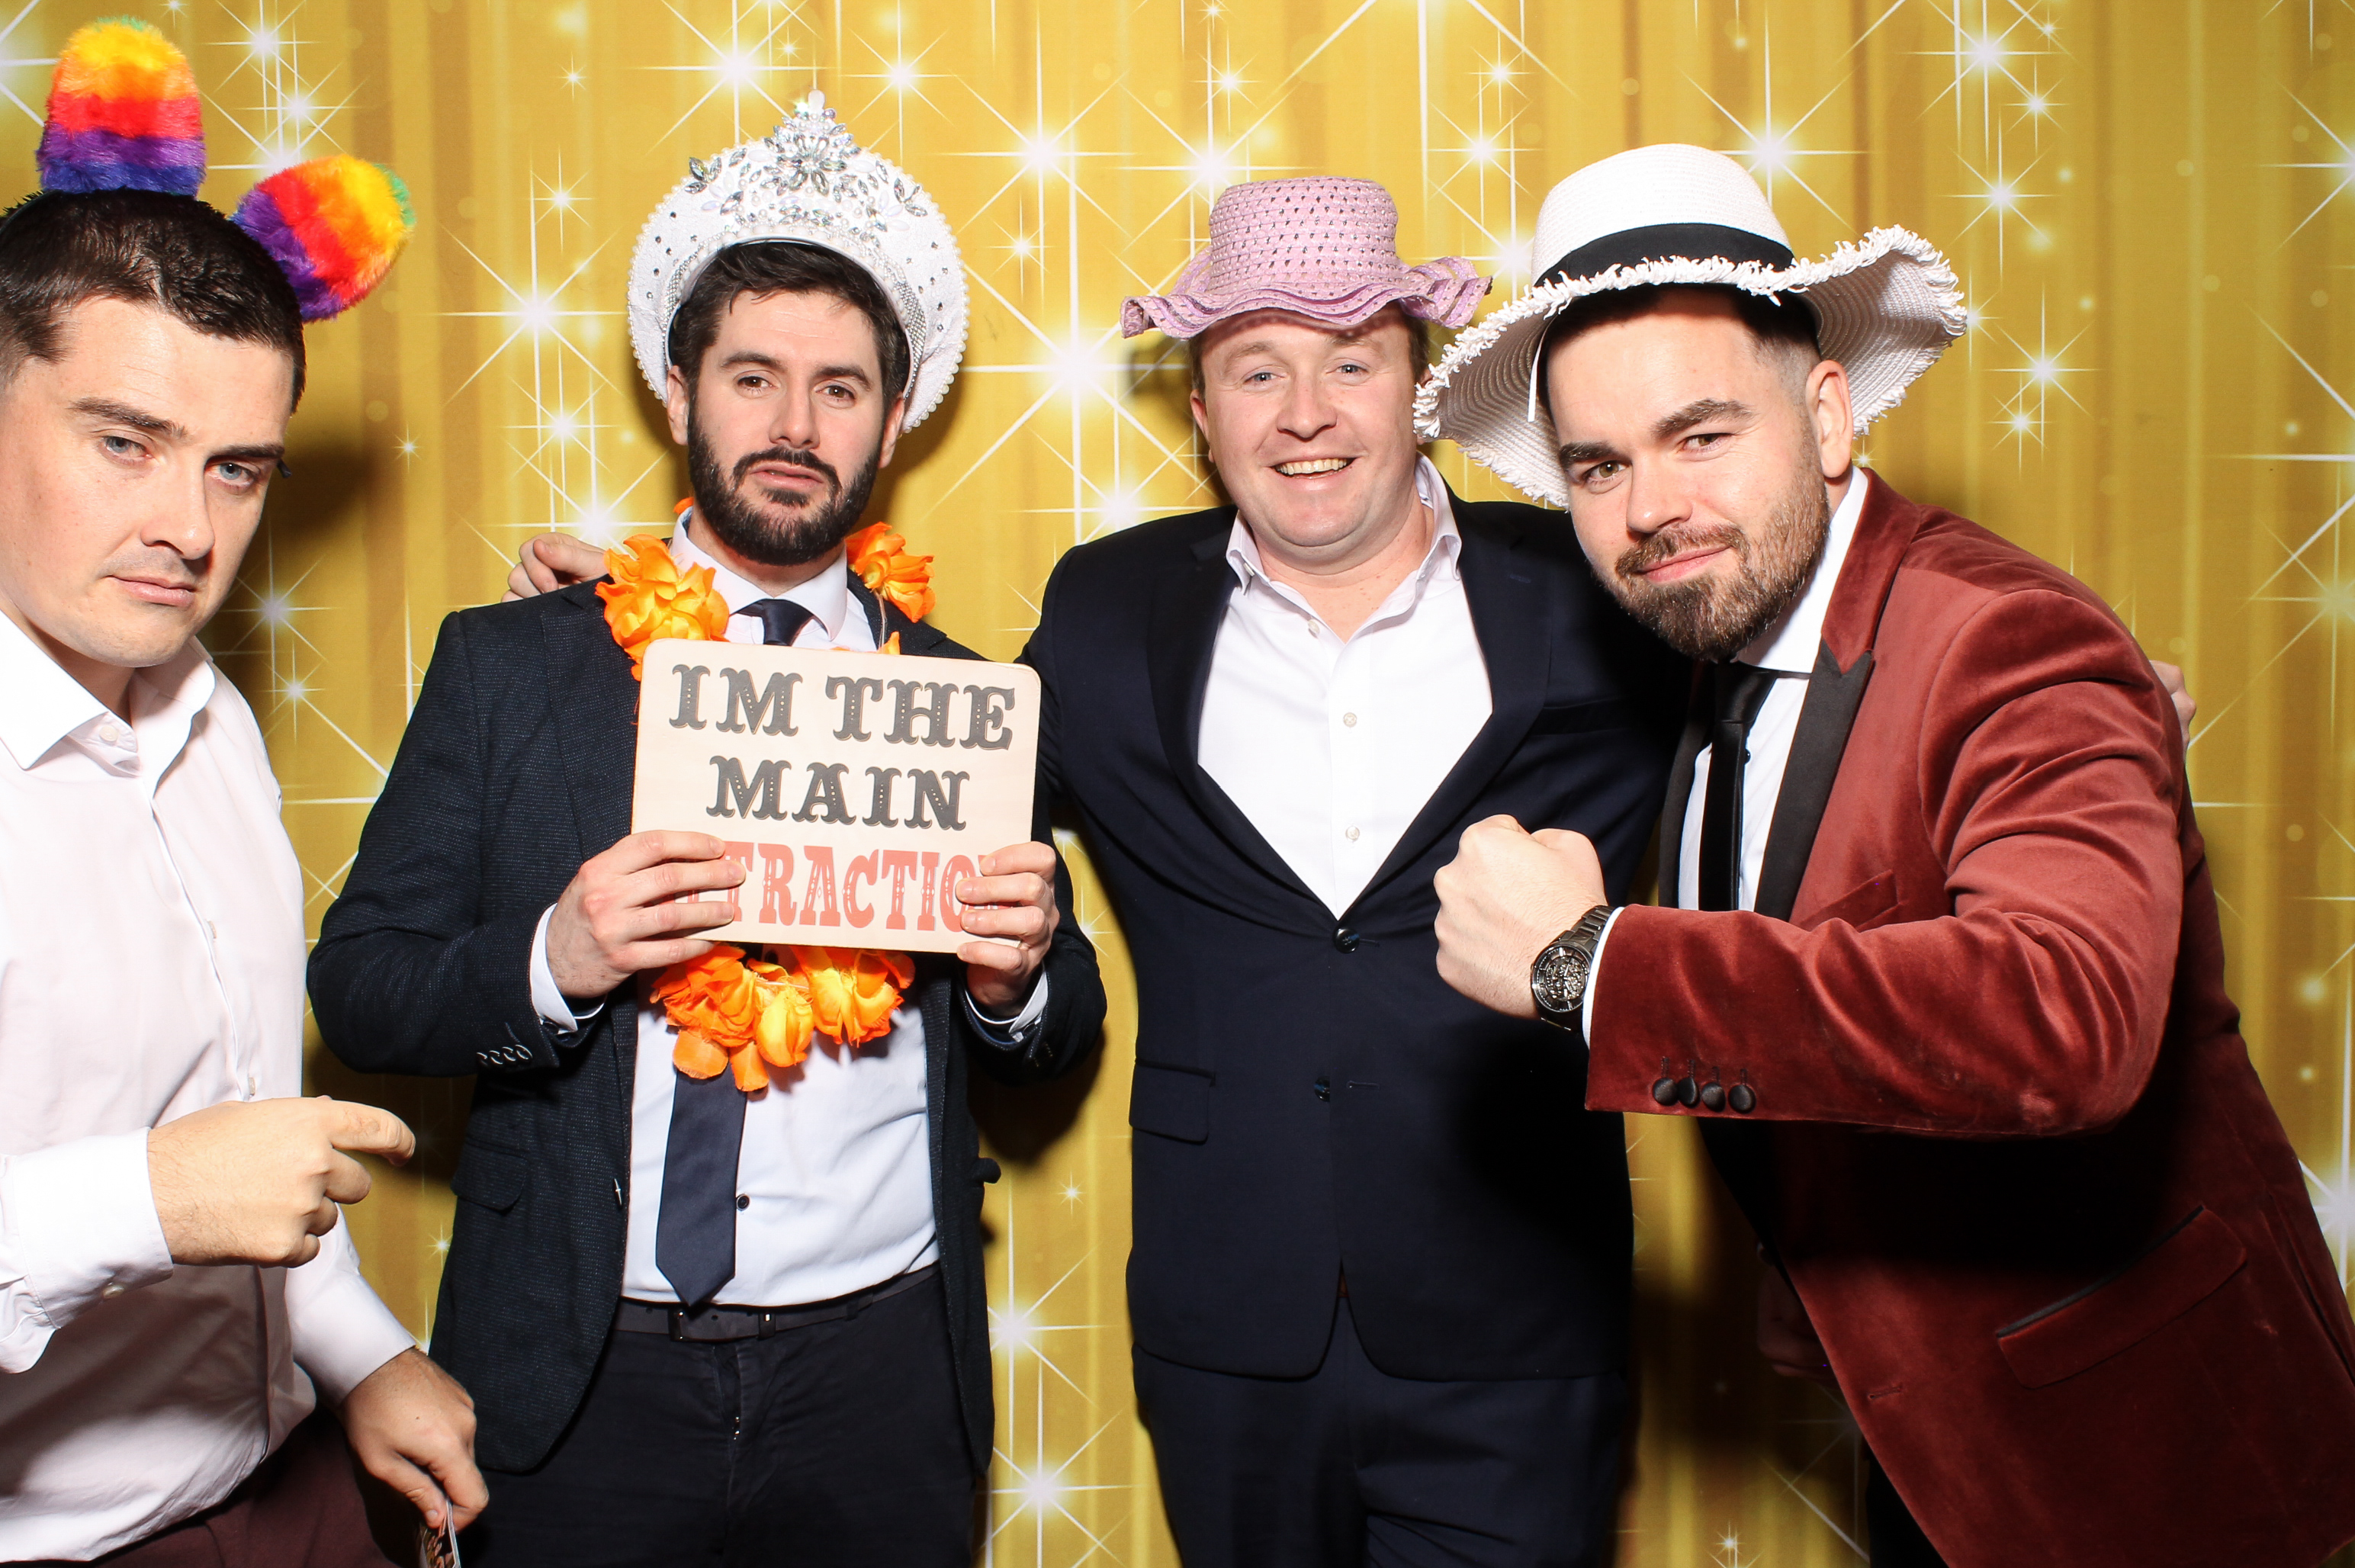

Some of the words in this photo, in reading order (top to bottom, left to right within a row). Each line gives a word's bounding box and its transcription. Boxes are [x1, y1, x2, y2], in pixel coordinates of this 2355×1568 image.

[669, 664, 803, 737] IM
[824, 675, 1016, 750] THE
[705, 755, 970, 831] MAIN
[647, 840, 1016, 933] TRACTIO
